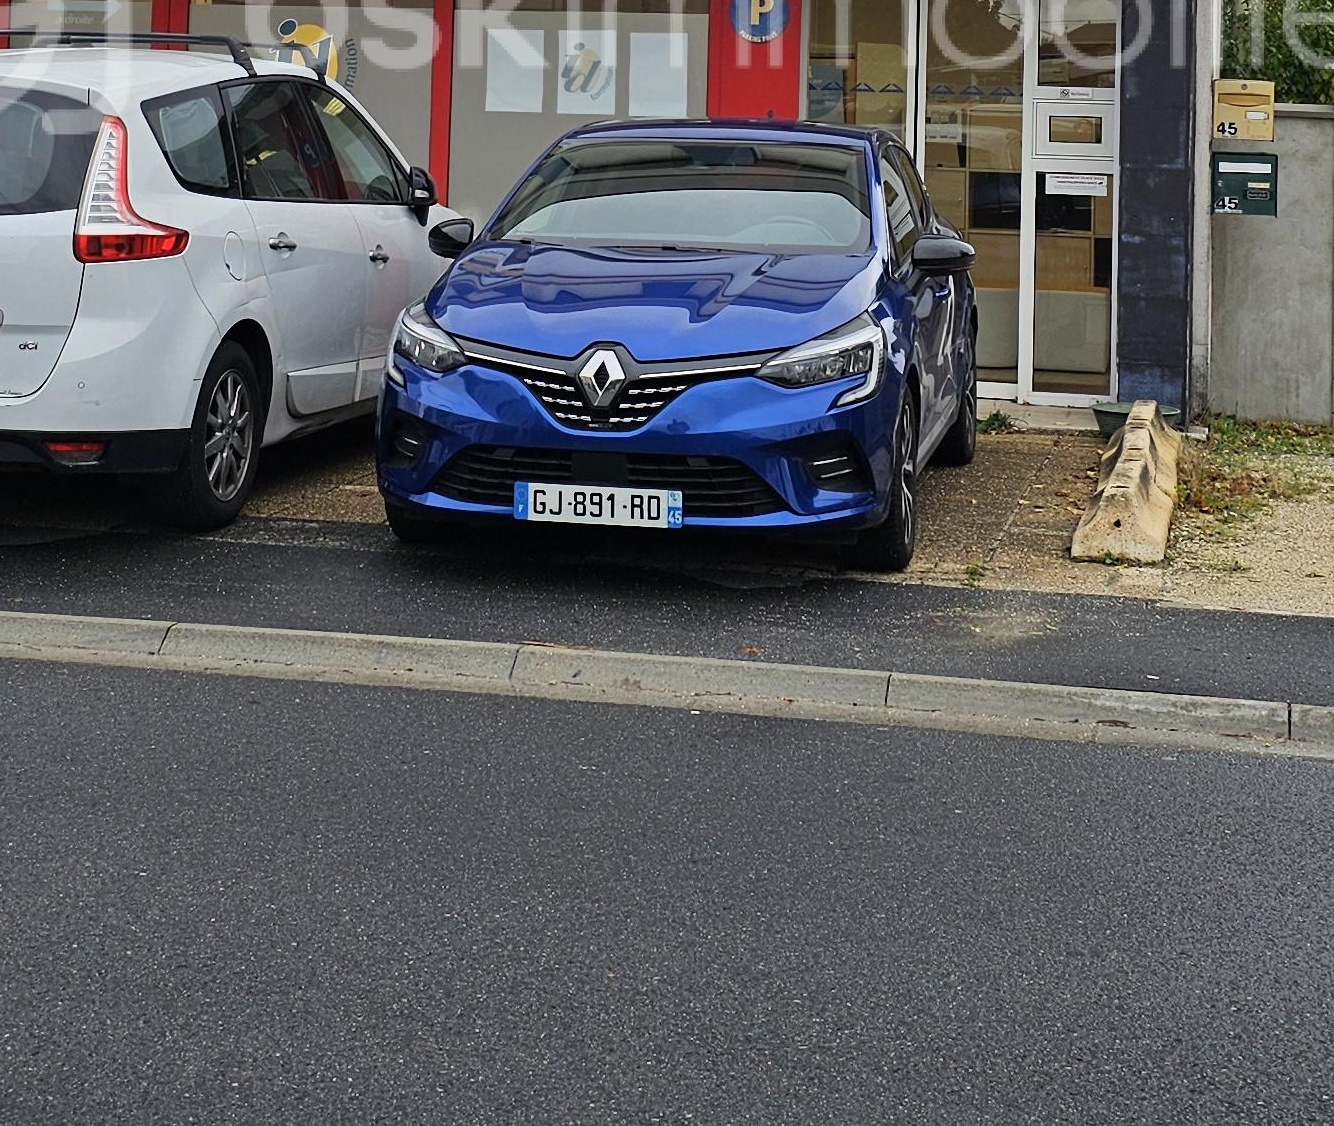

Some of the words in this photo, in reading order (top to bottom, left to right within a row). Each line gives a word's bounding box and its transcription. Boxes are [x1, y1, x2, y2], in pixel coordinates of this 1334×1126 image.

[1217, 121, 1238, 136] 45
[1214, 197, 1239, 211] 45
[518, 505, 524, 513] F
[533, 489, 661, 521] GJ-891-RD
[668, 510, 683, 524] 45
